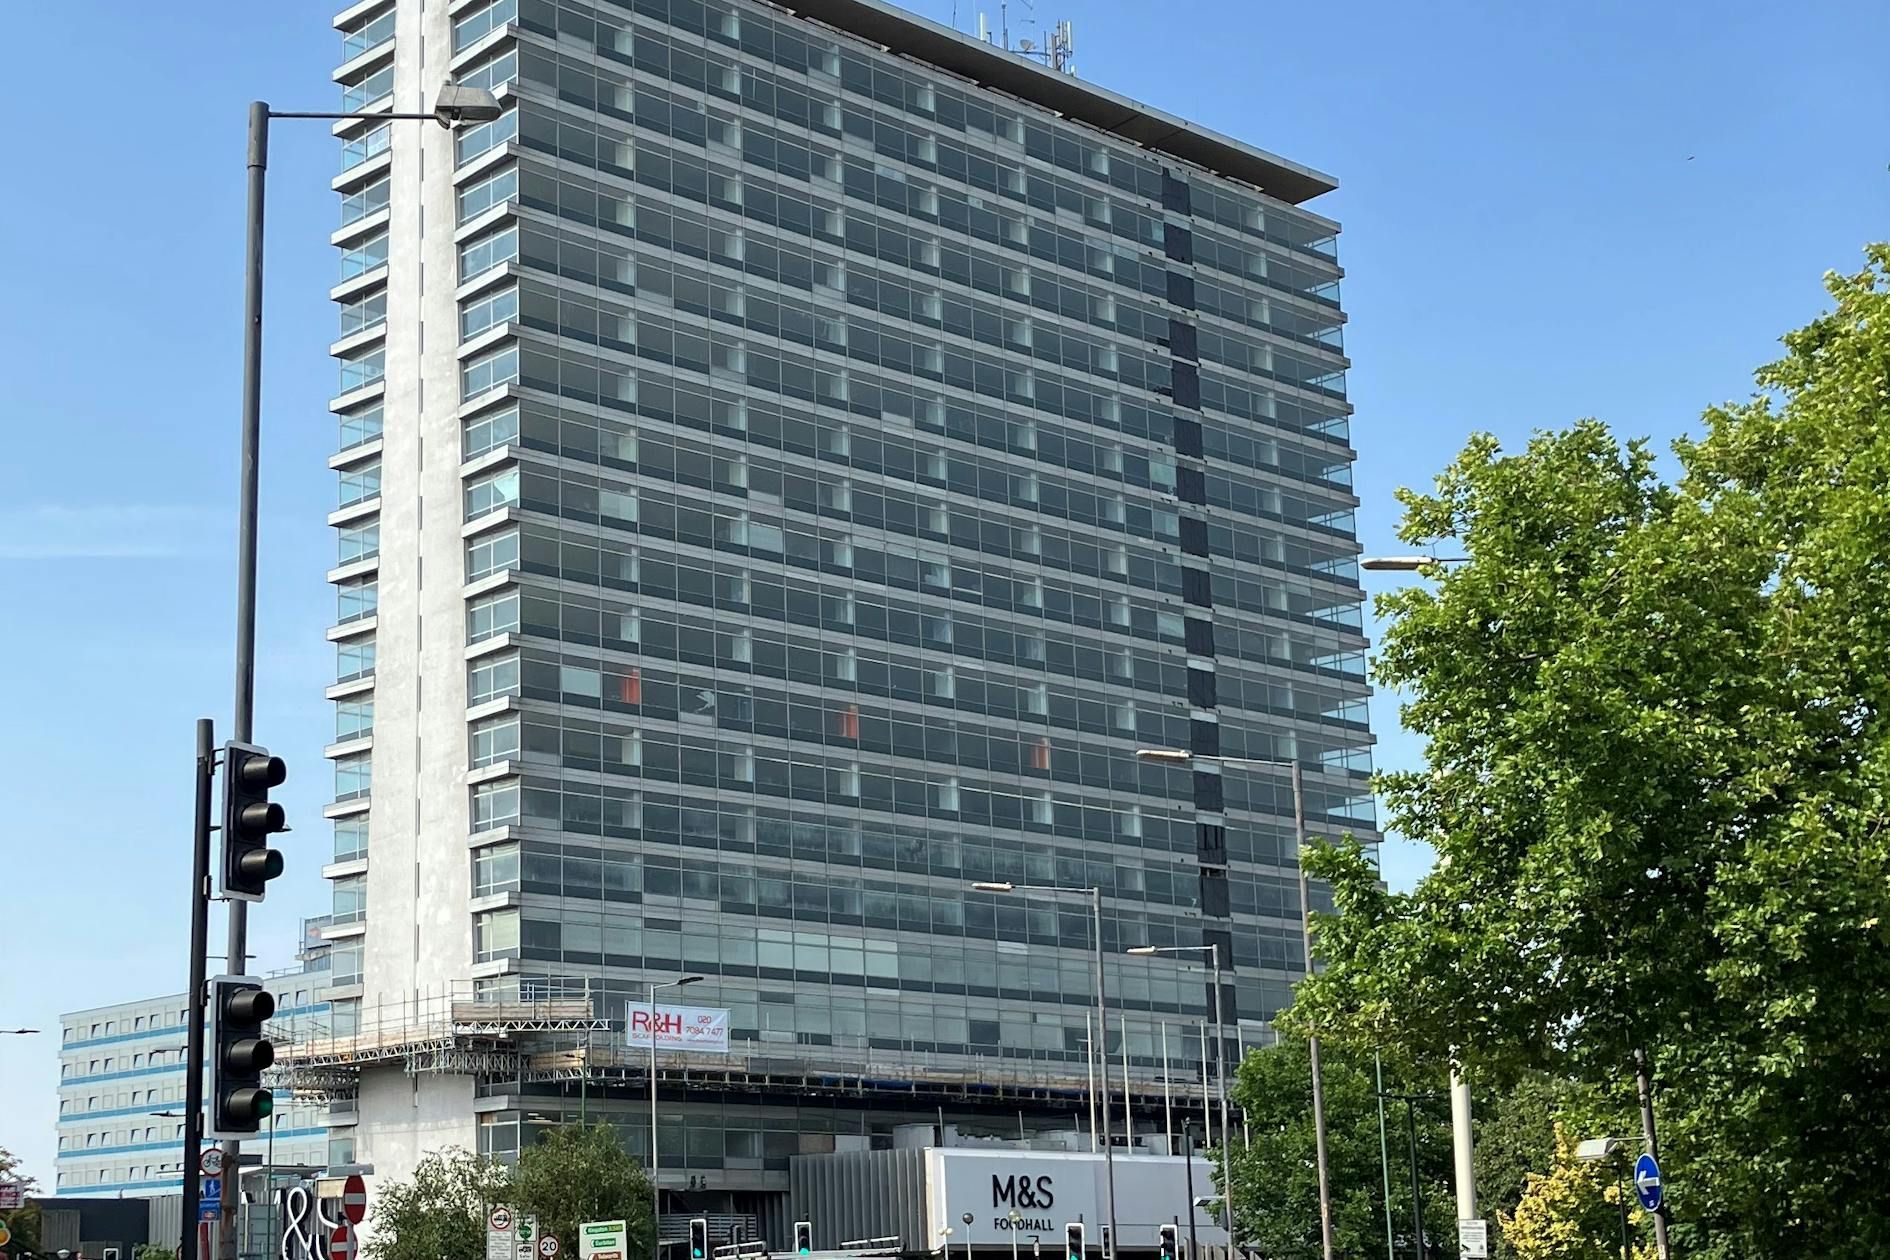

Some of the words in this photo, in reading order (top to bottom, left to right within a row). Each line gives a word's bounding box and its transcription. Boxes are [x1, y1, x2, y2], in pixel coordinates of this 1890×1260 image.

[632, 1011, 682, 1035] R&H
[992, 1174, 1054, 1209] M&S
[542, 1241, 557, 1251] 20
